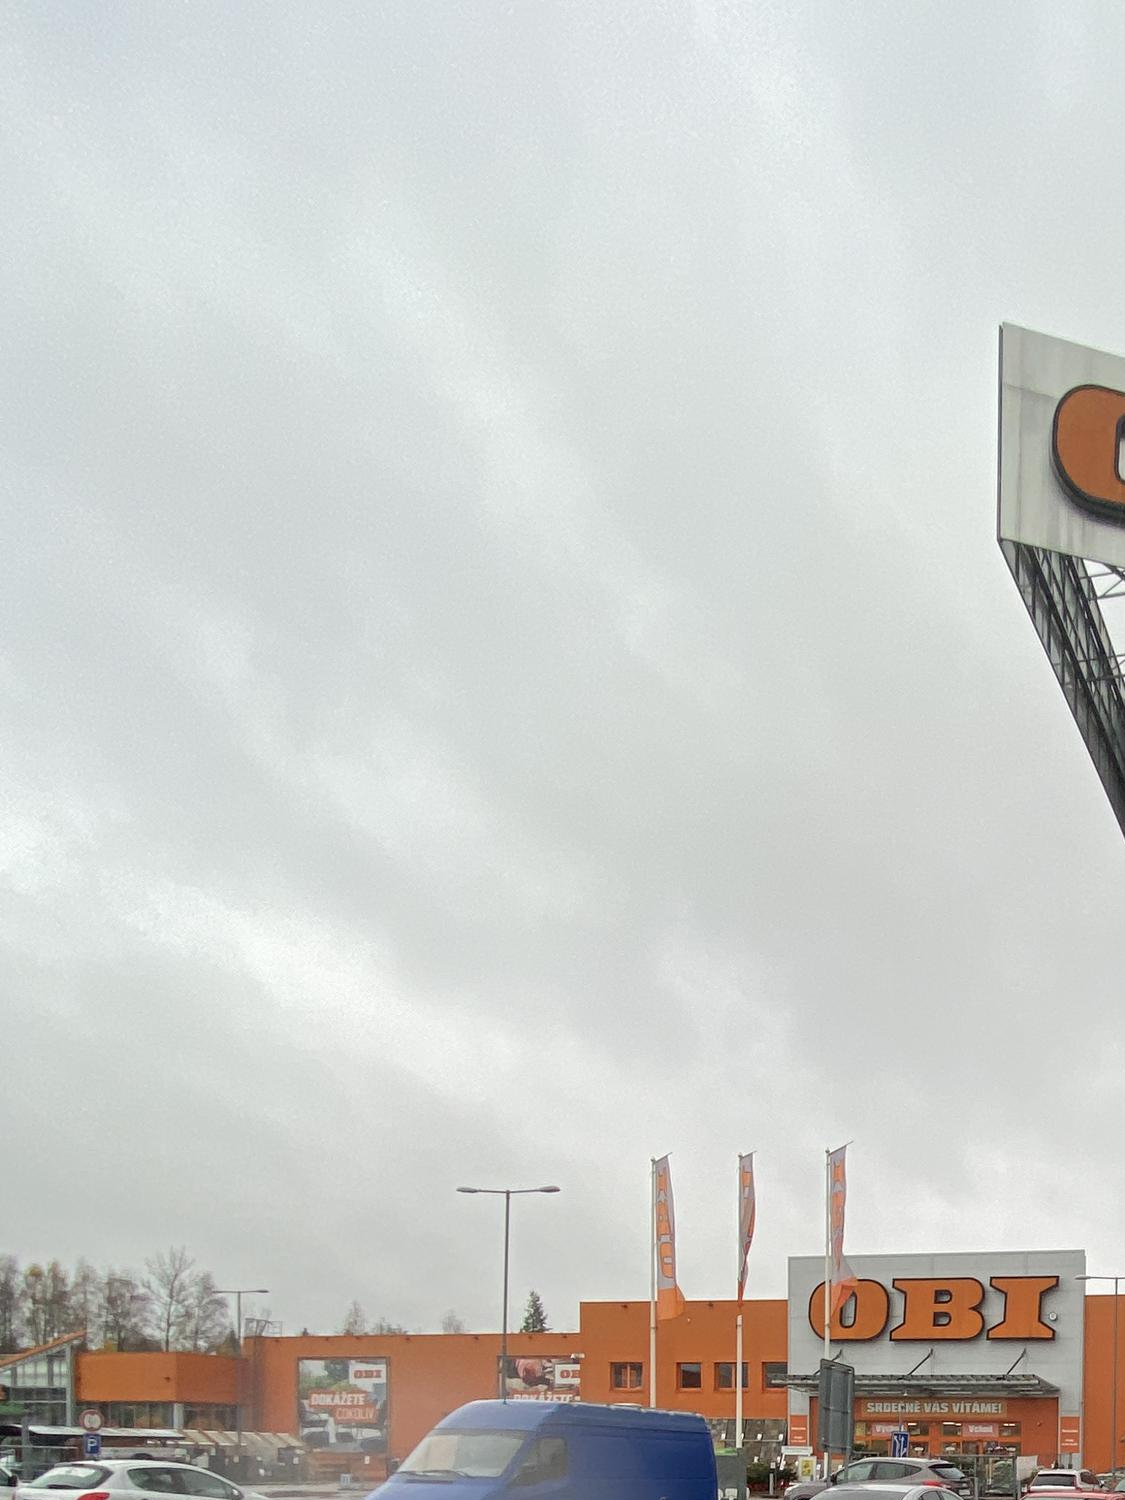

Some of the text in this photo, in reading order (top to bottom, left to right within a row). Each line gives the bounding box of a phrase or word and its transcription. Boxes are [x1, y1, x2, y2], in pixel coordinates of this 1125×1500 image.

[808, 1276, 1060, 1341] OBI
[353, 1369, 383, 1379] OBI
[560, 1369, 580, 1379] OB
[310, 1391, 367, 1406] DOKÁŽETE
[867, 1401, 921, 1413] SRDEČNĚ
[924, 1402, 949, 1413] VÁS
[87, 1437, 97, 1452] P
